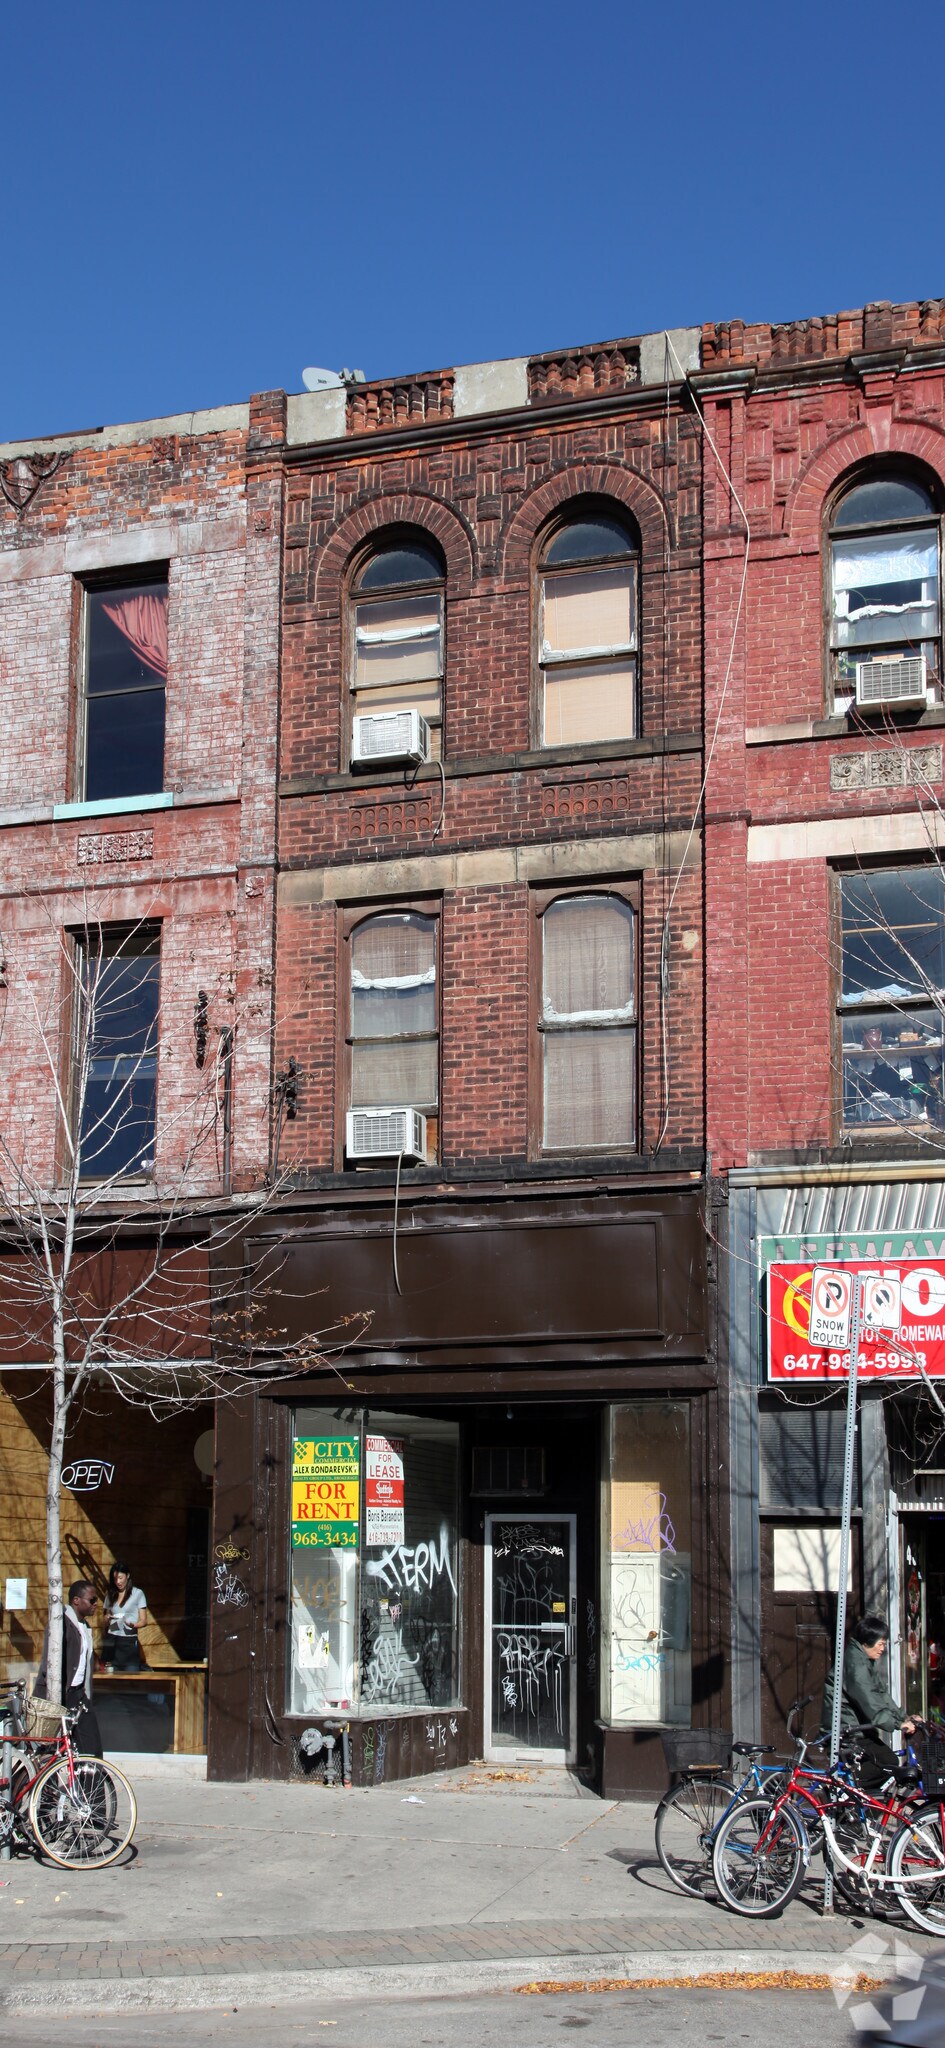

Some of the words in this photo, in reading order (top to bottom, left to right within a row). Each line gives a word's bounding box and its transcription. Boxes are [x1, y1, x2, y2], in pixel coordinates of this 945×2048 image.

[816, 1319, 844, 1331] SNOW
[813, 1332, 845, 1345] ROUTE
[892, 1325, 945, 1342] HOMEWA
[783, 1352, 927, 1370] 647-984-5998
[314, 1442, 358, 1457] CITY
[367, 1439, 404, 1453] COMMERCIAL
[378, 1454, 392, 1463] FOR
[60, 1465, 115, 1485] OPEN
[294, 1466, 309, 1474] ALEX
[370, 1465, 400, 1478] LEASE
[305, 1483, 346, 1499] FOR
[297, 1502, 355, 1519] RENT
[368, 1509, 380, 1522] Boris
[318, 1524, 332, 1532] (416)
[293, 1532, 357, 1545] 968-3434
